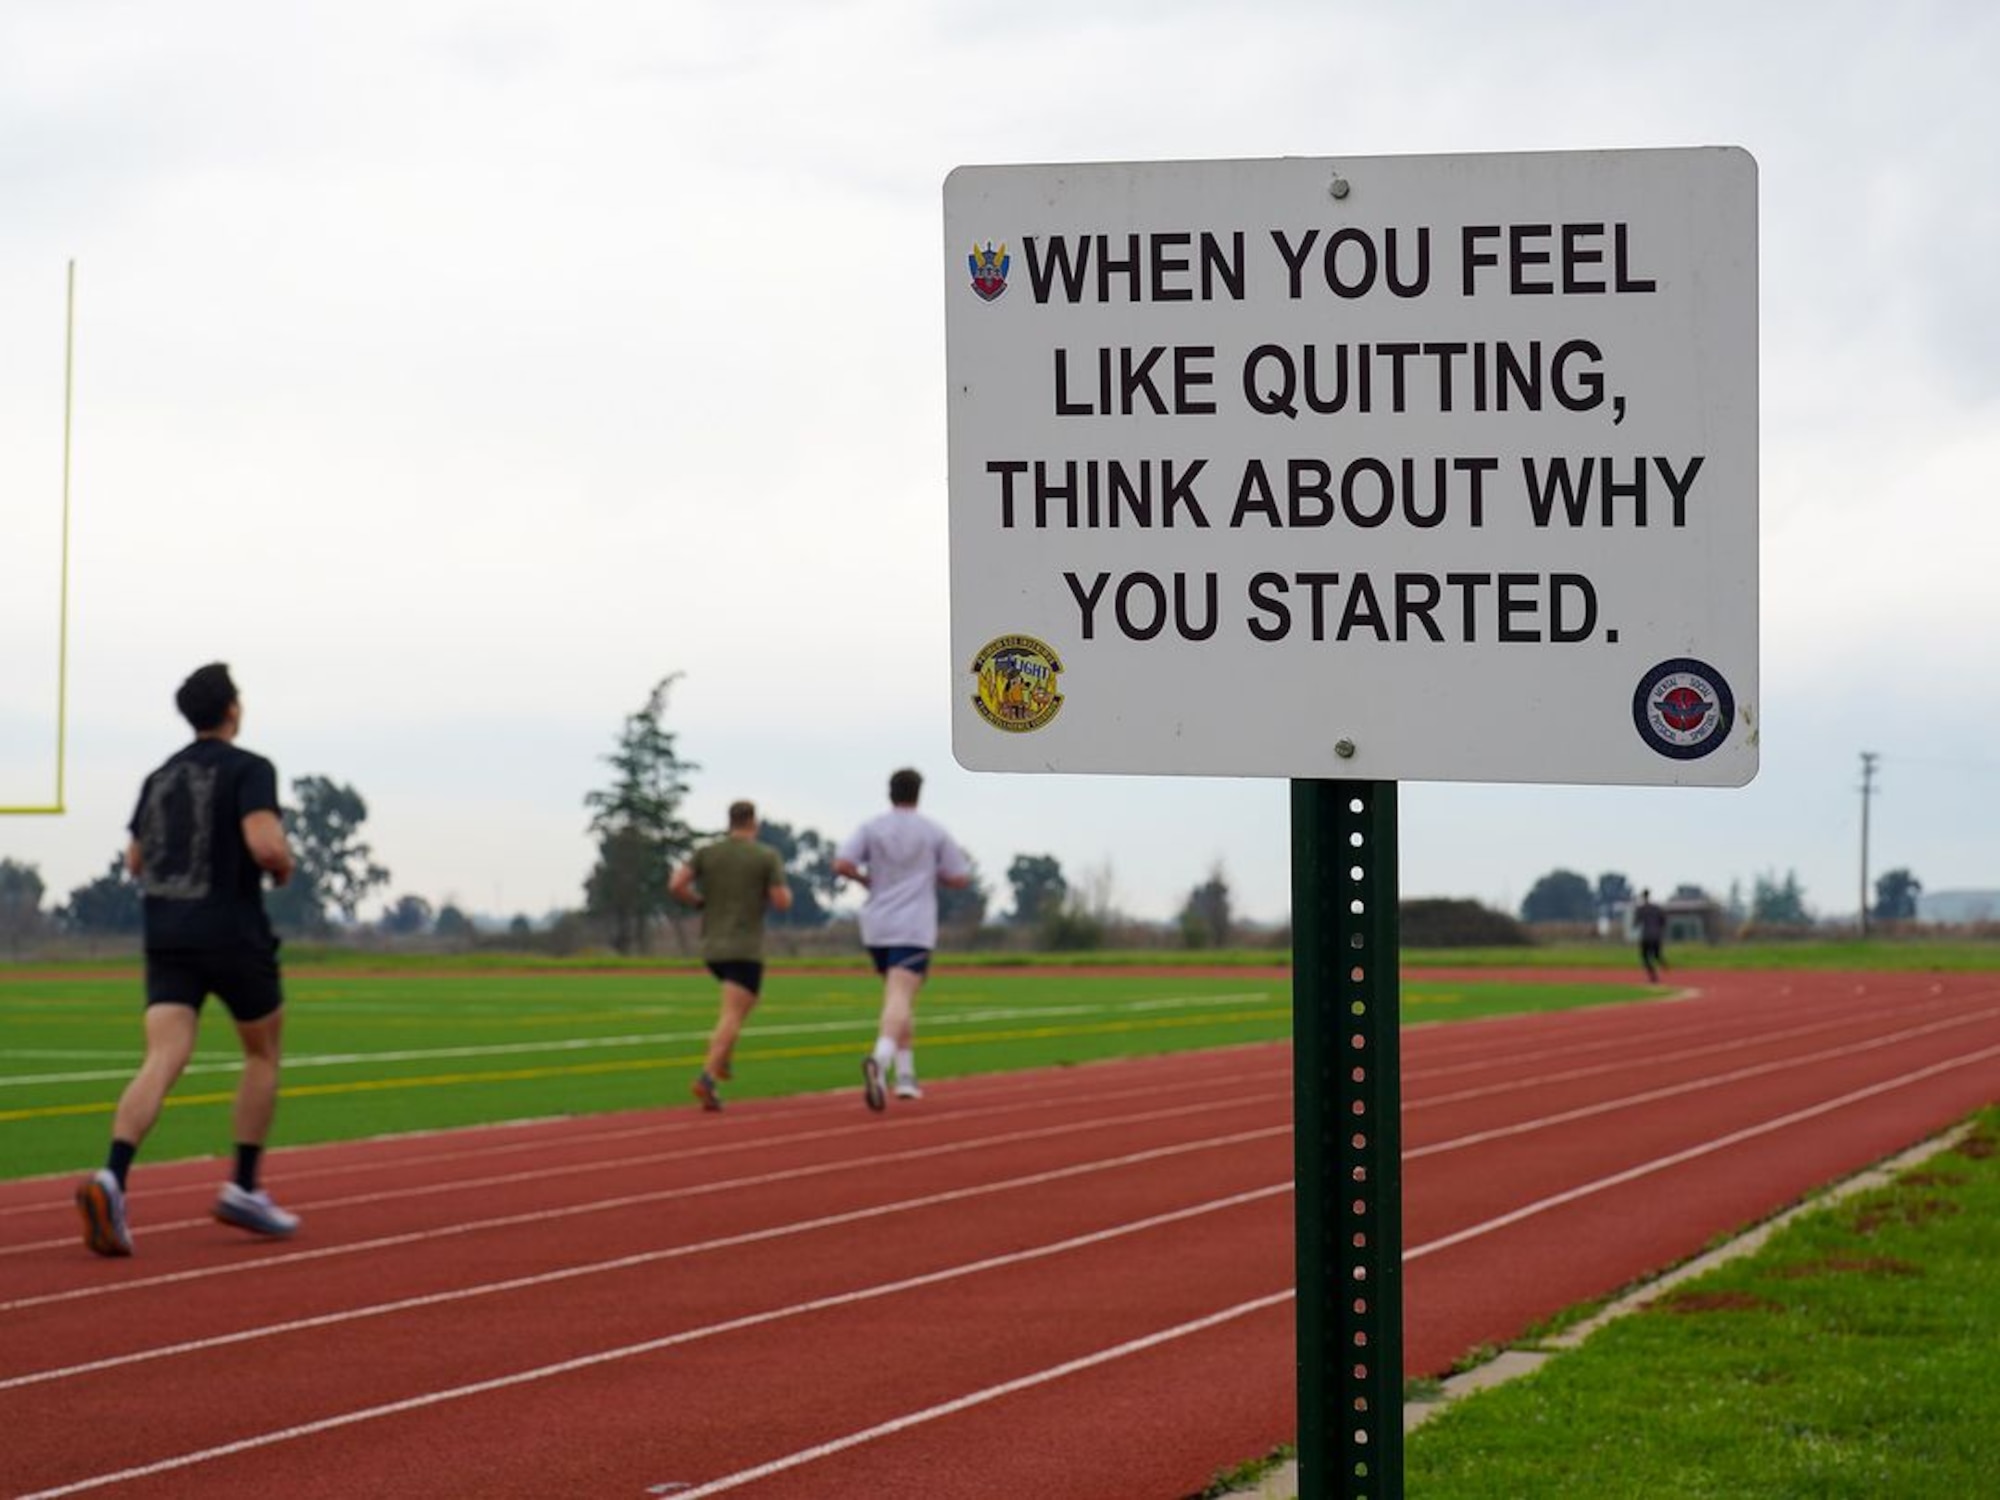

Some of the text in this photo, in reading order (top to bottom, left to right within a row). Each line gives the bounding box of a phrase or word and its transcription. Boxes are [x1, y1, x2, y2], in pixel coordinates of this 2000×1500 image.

[1022, 222, 1657, 304] WHEN YOU FEEL
[1054, 339, 1628, 427] LIKE QUITTING,
[986, 456, 1706, 529] THINK ABOUT WHY
[1062, 571, 1620, 643] YOU STARTED.
[1654, 677, 1679, 697] MENTAL
[1689, 677, 1712, 698] SOCIAL
